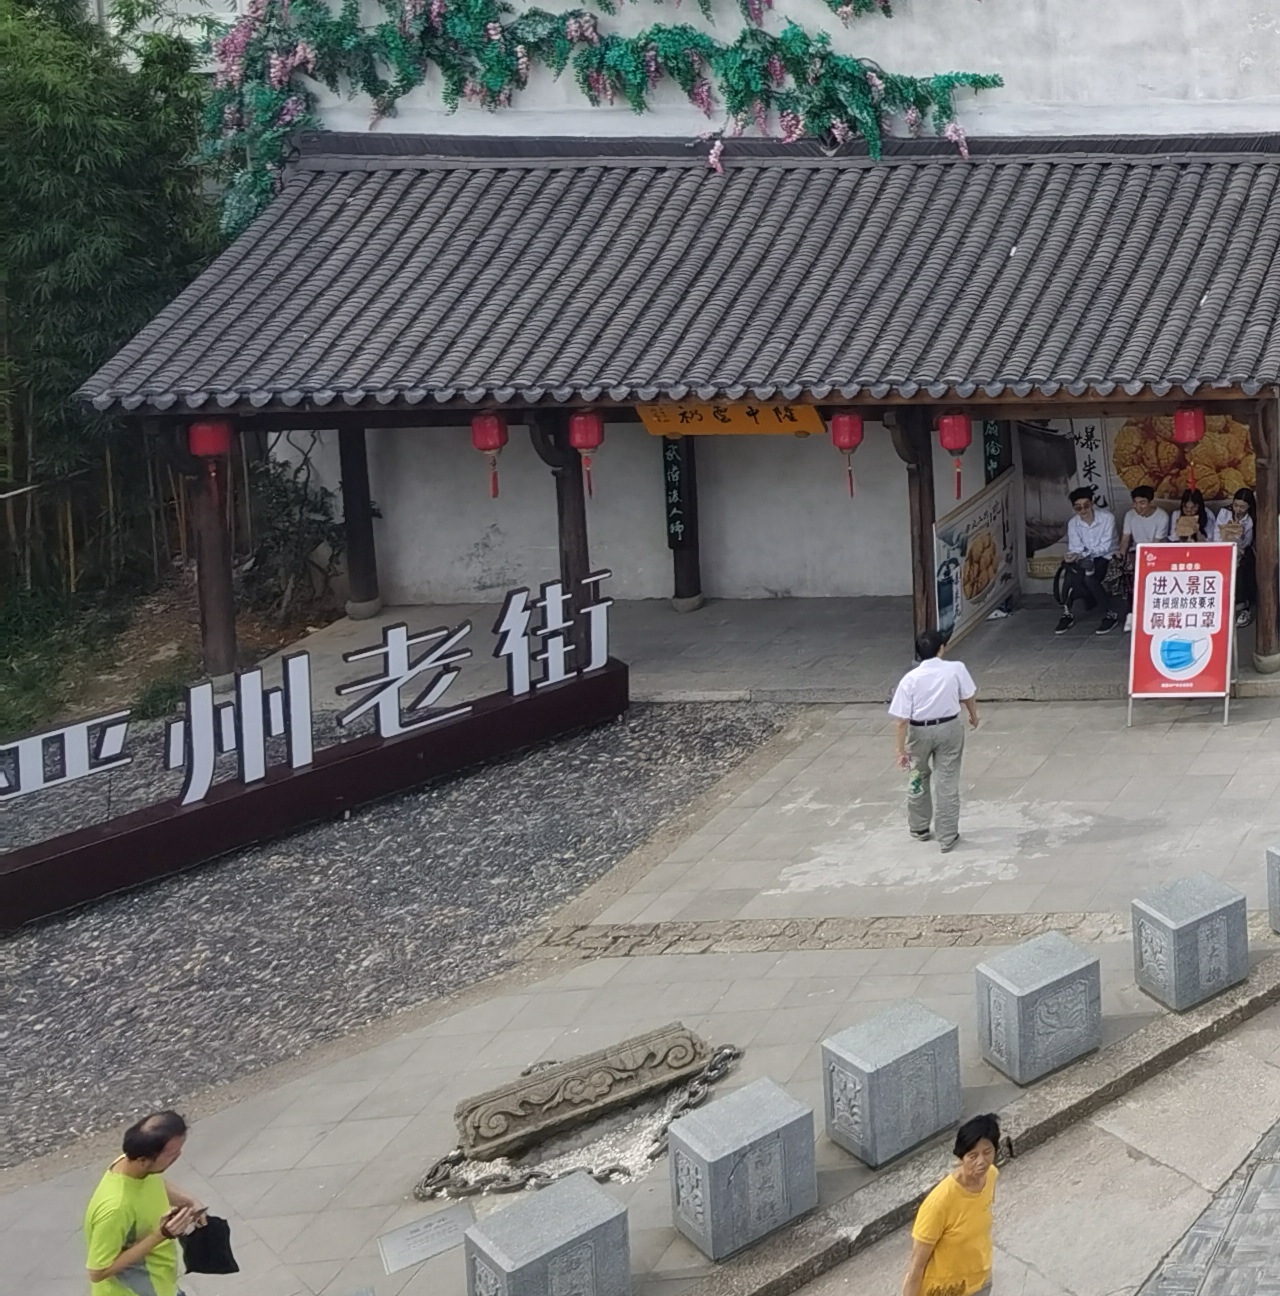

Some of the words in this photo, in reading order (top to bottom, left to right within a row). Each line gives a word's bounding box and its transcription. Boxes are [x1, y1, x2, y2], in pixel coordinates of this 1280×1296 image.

[1152, 576, 1217, 595] 进入景区
[1152, 596, 1216, 610] 请根据防疫要求
[1150, 611, 1215, 630] 佩戴口罩
